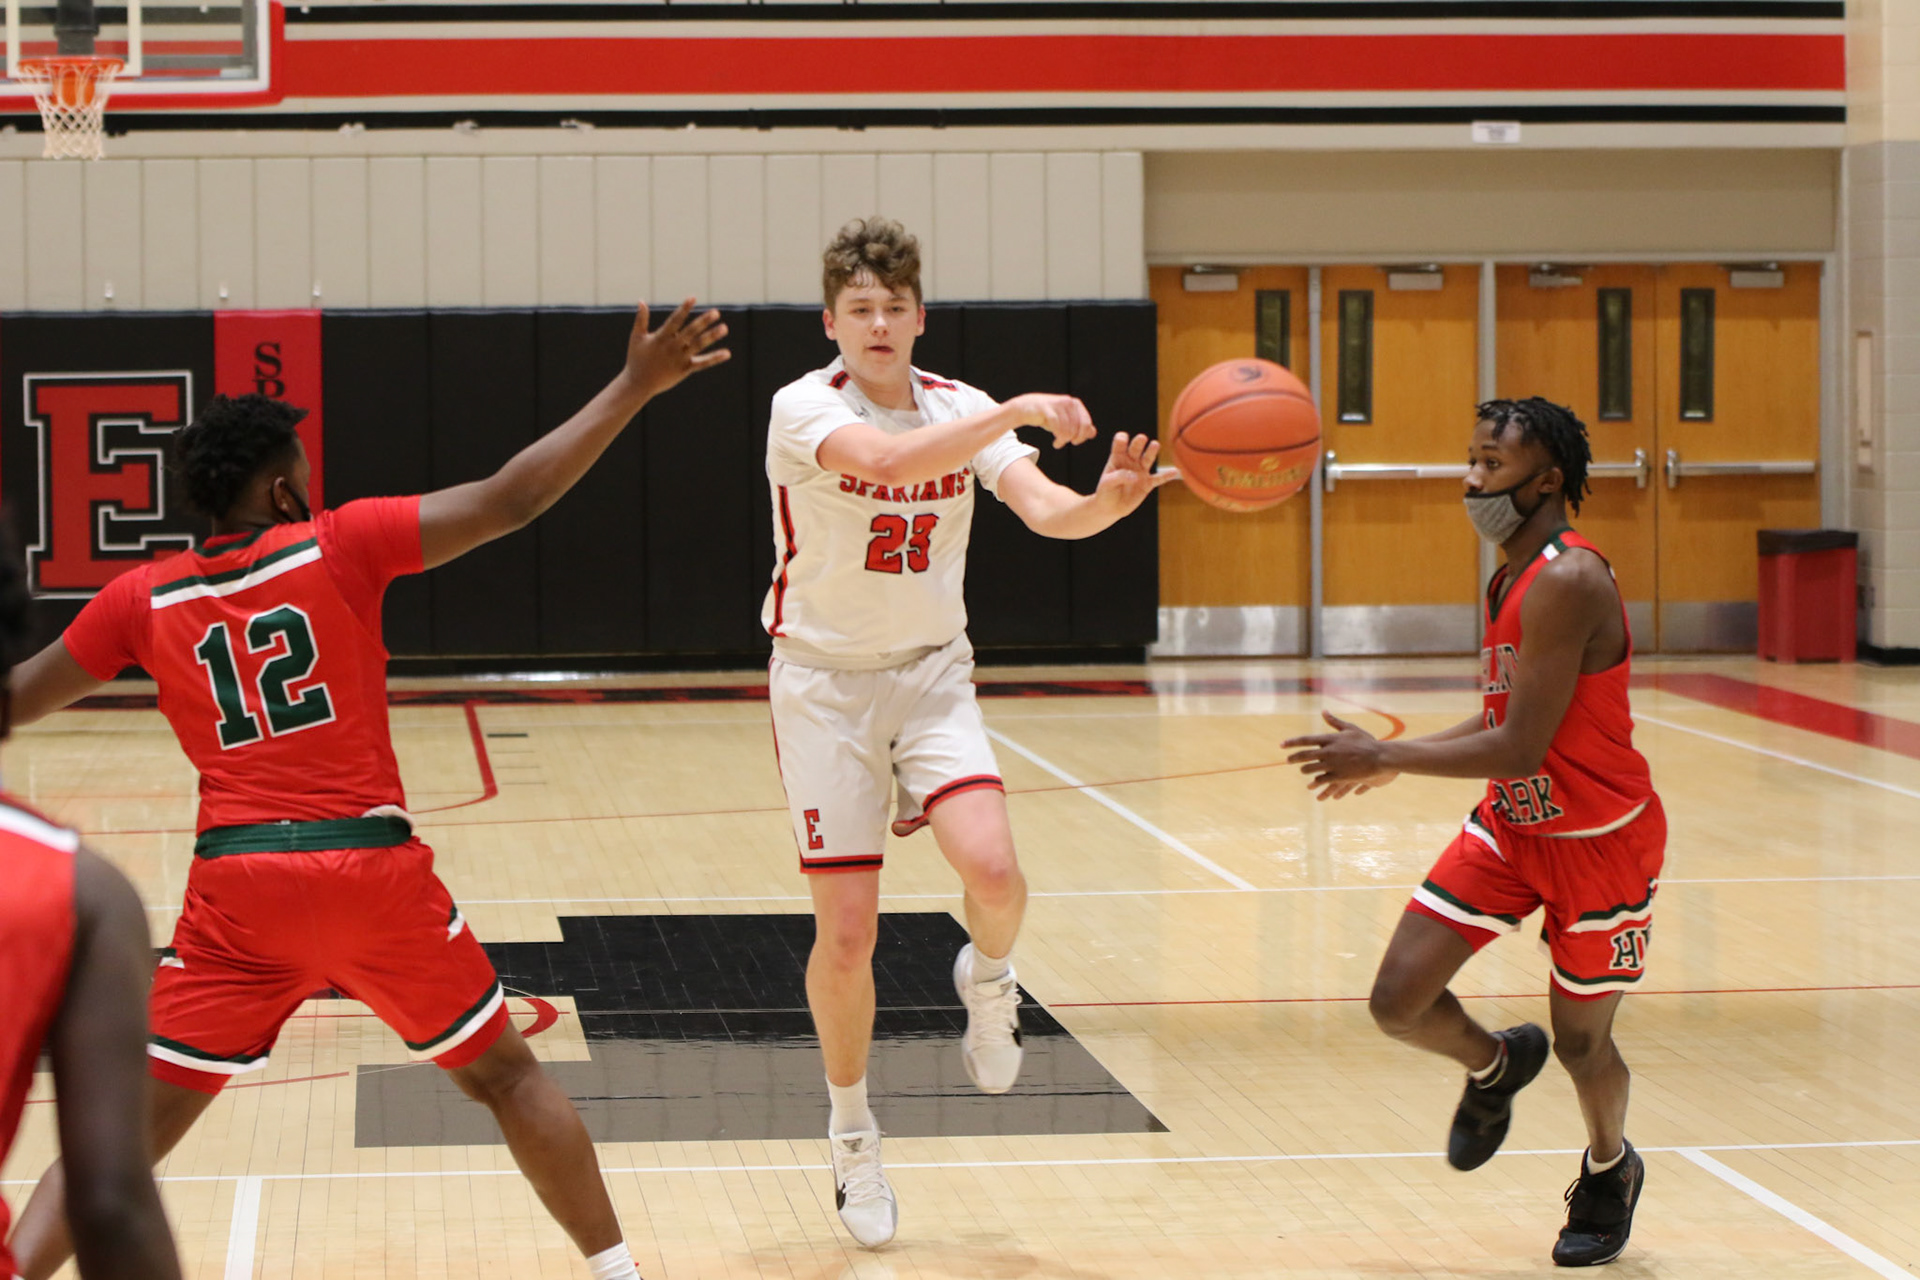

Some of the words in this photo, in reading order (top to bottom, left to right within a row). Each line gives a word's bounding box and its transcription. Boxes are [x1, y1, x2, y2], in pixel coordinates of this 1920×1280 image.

[24, 370, 193, 600] E
[864, 512, 940, 575] 23
[193, 602, 337, 751] 12
[803, 808, 824, 851] E
